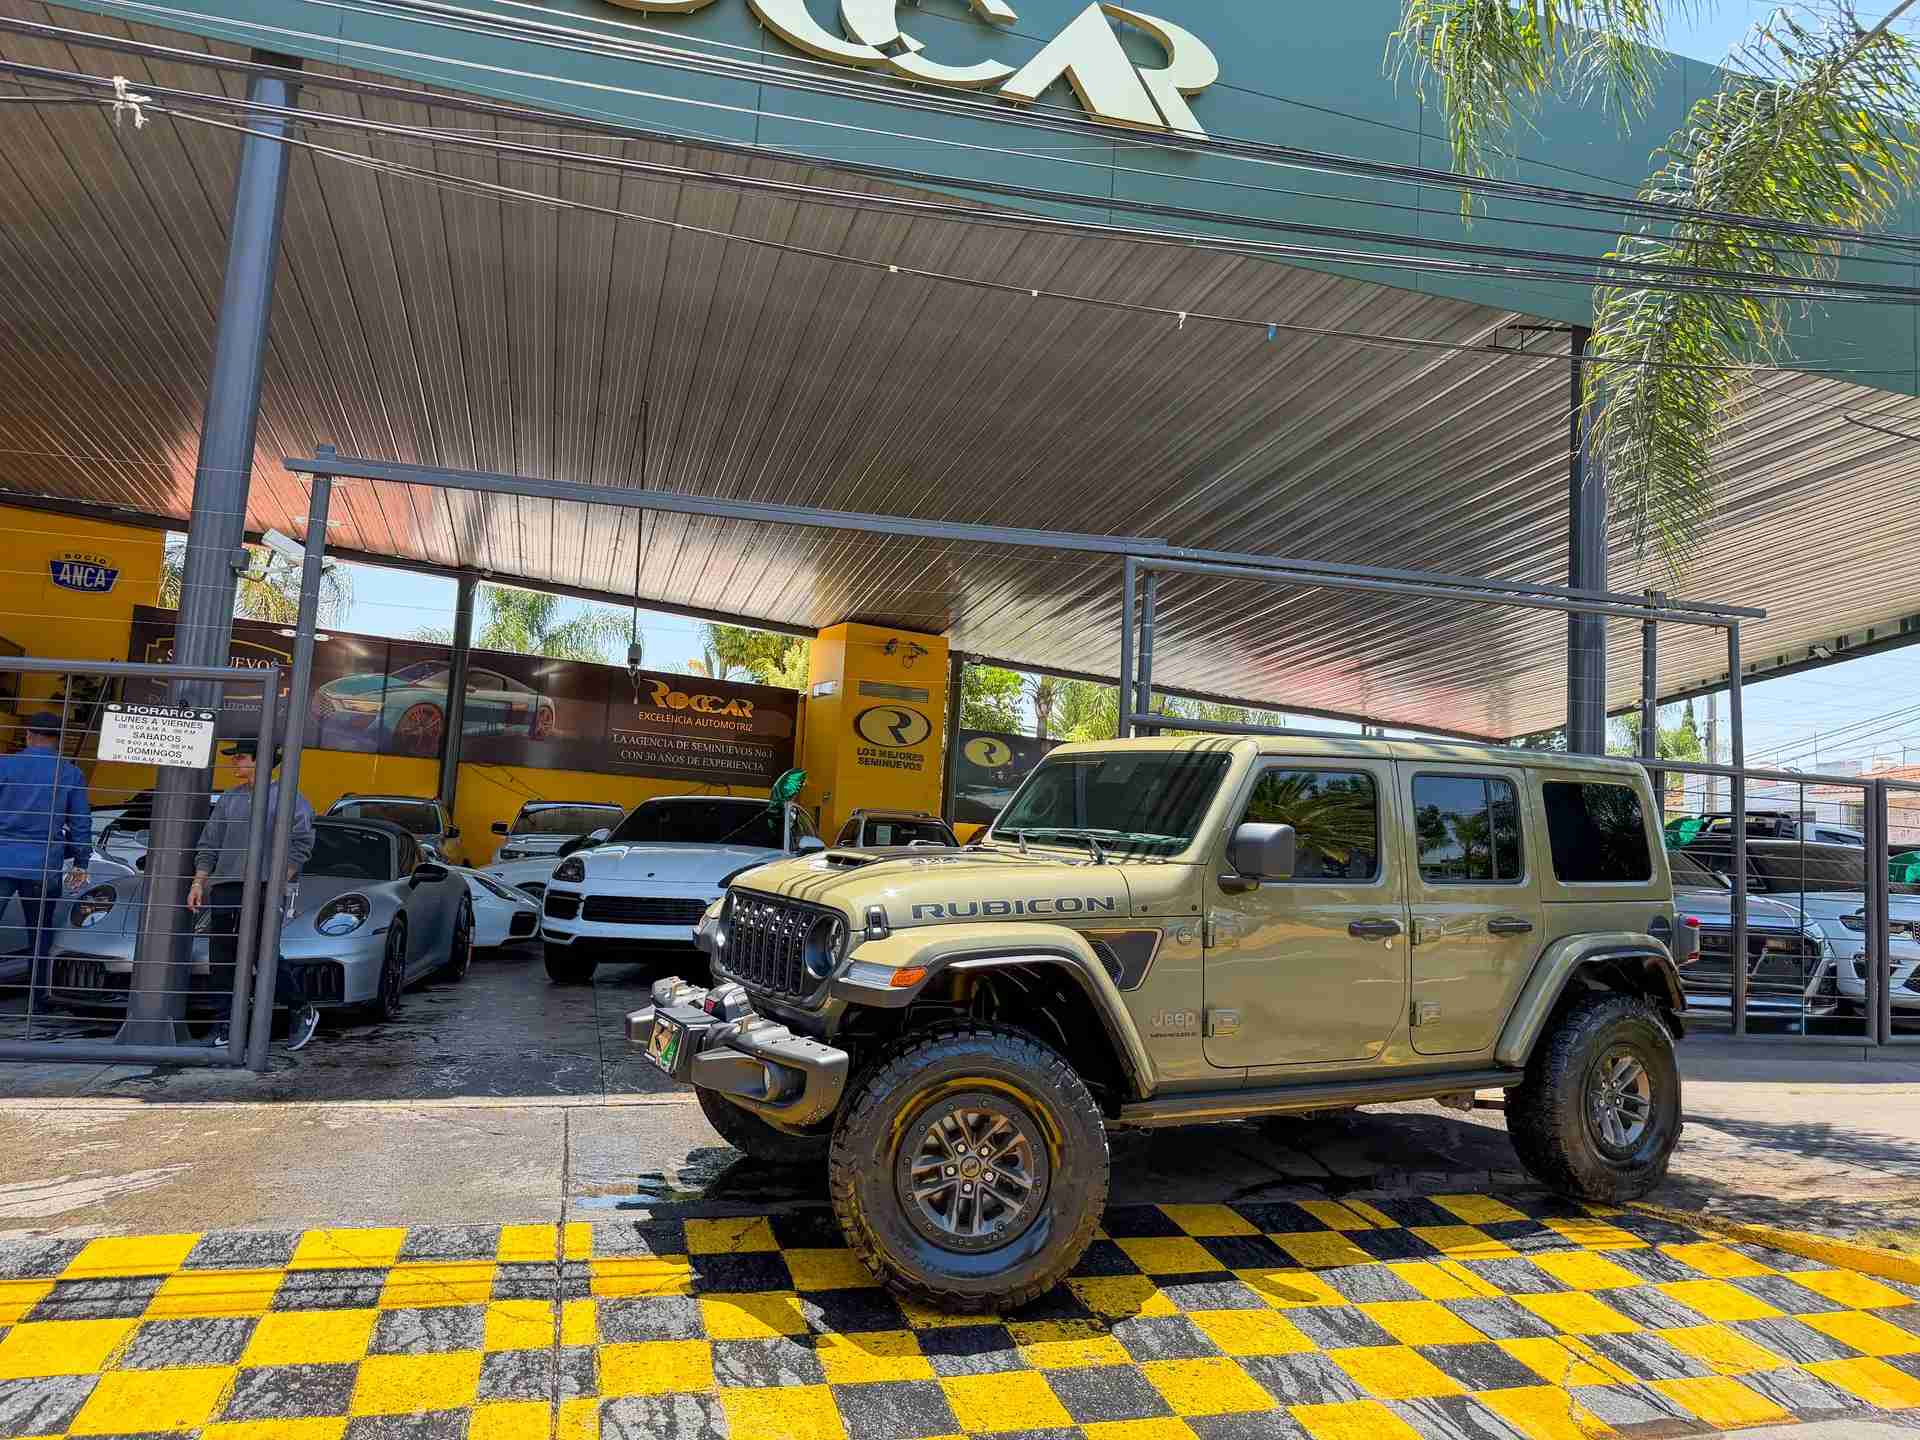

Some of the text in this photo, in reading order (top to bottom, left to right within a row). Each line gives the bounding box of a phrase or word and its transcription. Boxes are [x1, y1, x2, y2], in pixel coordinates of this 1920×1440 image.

[59, 563, 106, 588] ANCA
[641, 678, 754, 718] ROCCAR
[114, 714, 204, 729] LUNES A VIERNES
[126, 704, 196, 719] HORARIO
[638, 711, 753, 732] EXCELENCIA AUTOMOTRIZ
[132, 731, 182, 743] SABADOS
[612, 733, 626, 744] LA
[626, 735, 674, 750] AGENCIA
[676, 741, 690, 751] DE
[691, 742, 753, 756] SEMINUEVOS
[127, 746, 183, 759] DOMINGOS
[621, 750, 643, 761] CON
[658, 751, 685, 764] AÑOS
[687, 755, 702, 766] DE
[702, 757, 765, 771] EXPERIENCIA
[857, 746, 925, 763] LOS MEJORES
[857, 756, 923, 771] SEMINUEVOS
[911, 896, 1115, 920] RUBICON
[1151, 1009, 1196, 1031] Jeep
